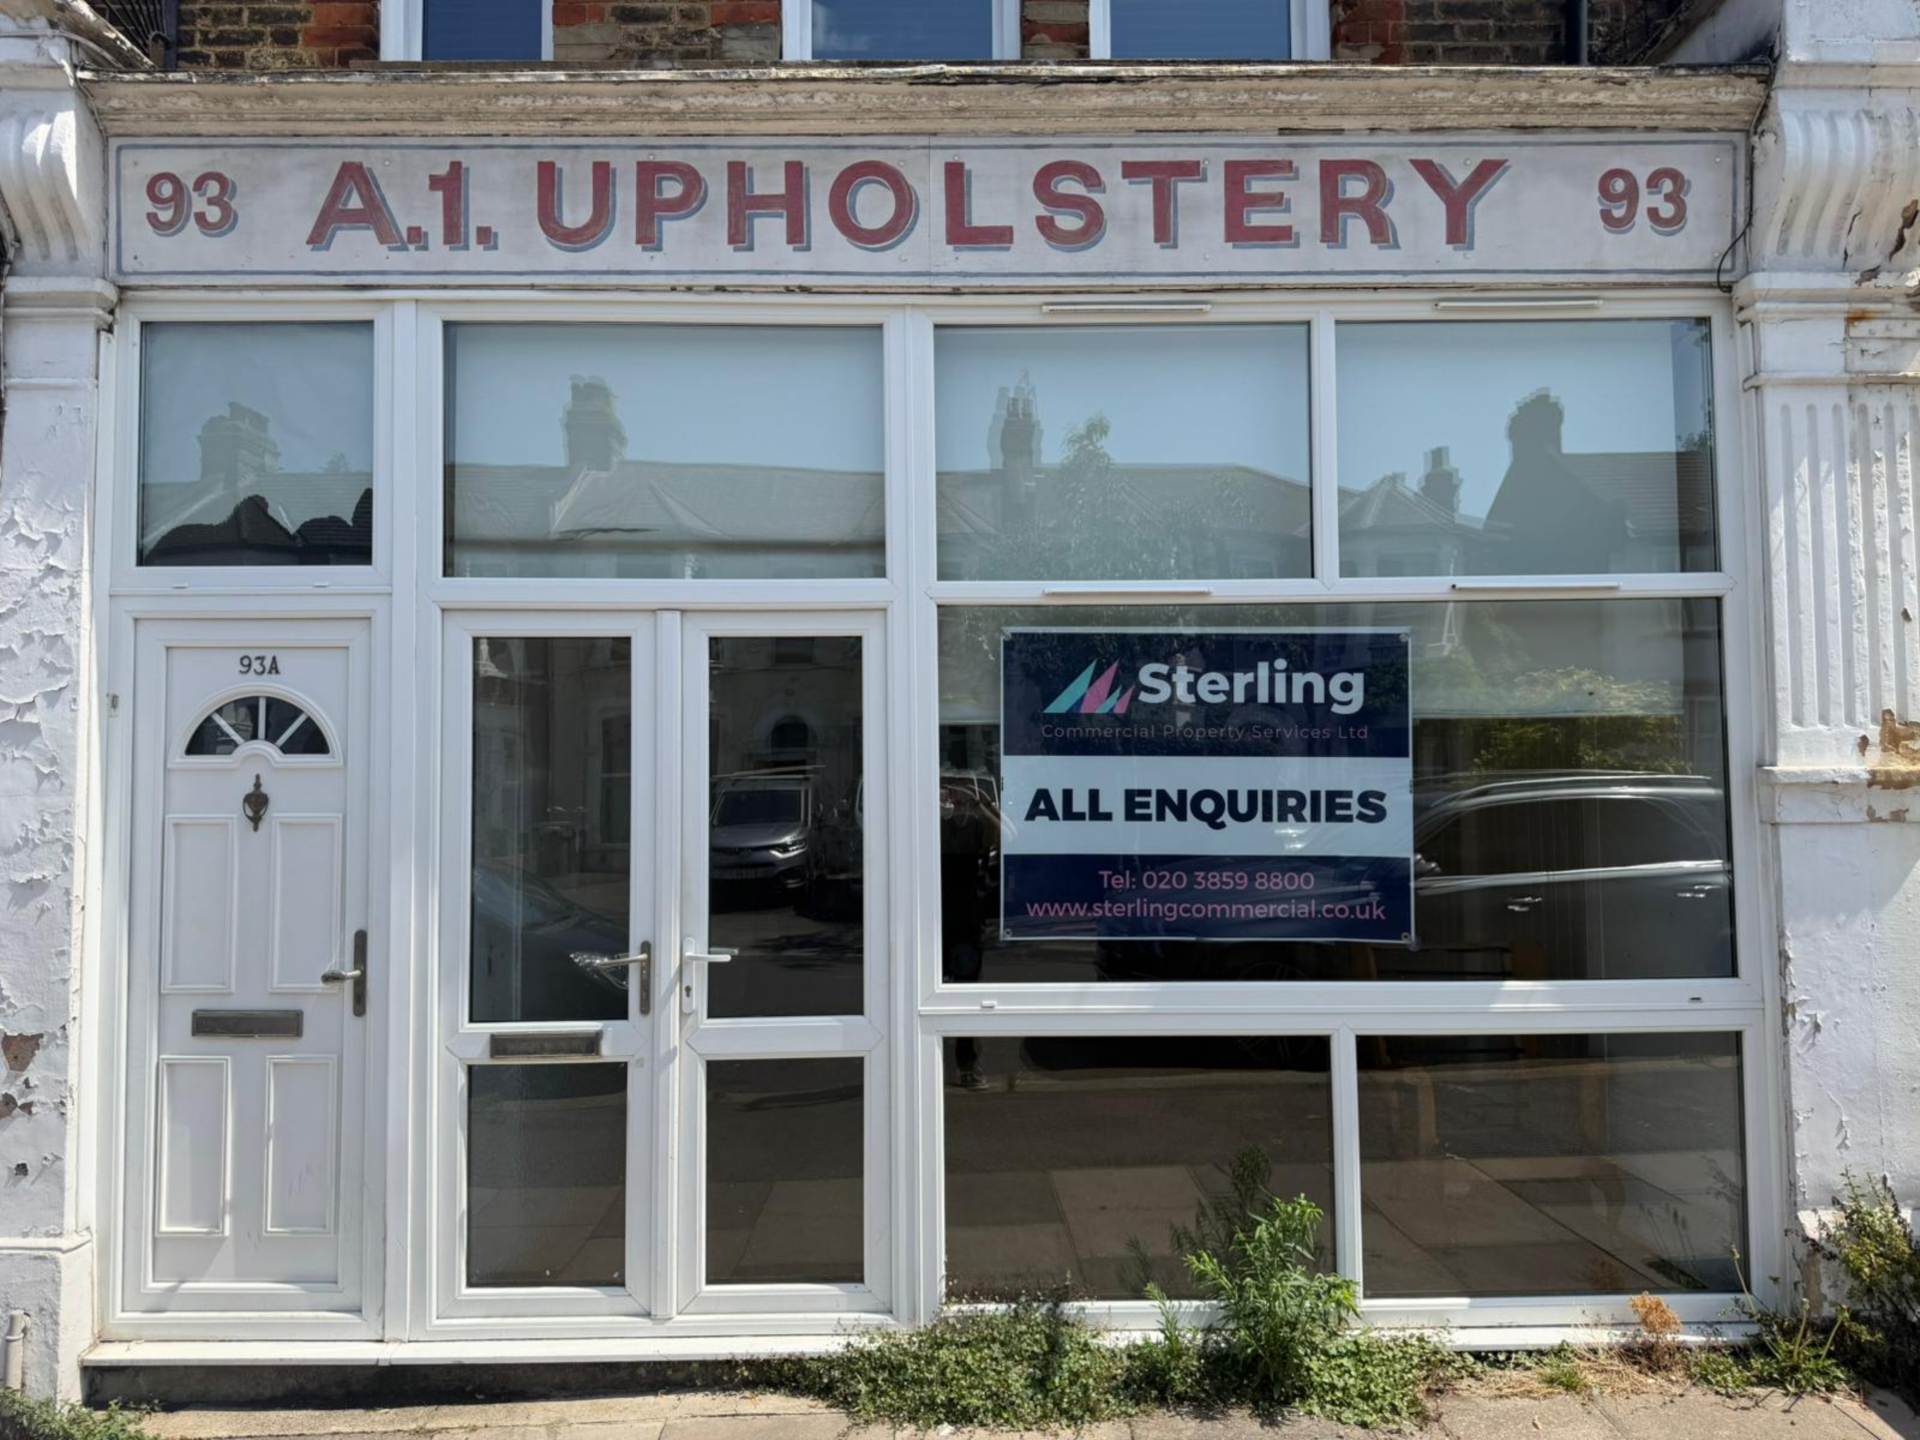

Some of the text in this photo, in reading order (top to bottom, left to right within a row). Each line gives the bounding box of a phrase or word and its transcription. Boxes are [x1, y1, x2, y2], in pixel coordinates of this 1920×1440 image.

[145, 157, 1691, 253] 93 A.1. UPHOLSTERY 93
[238, 654, 281, 676] 93A
[1137, 658, 1366, 716] Sterling
[1041, 723, 1369, 742] Commercial Property Services Ltd
[1024, 788, 1389, 830] ALL ENQUIRIES
[1099, 870, 1316, 891] Tel: 020 3859 8800
[1025, 899, 1387, 922] www.sterlingcommercial.co.uk
